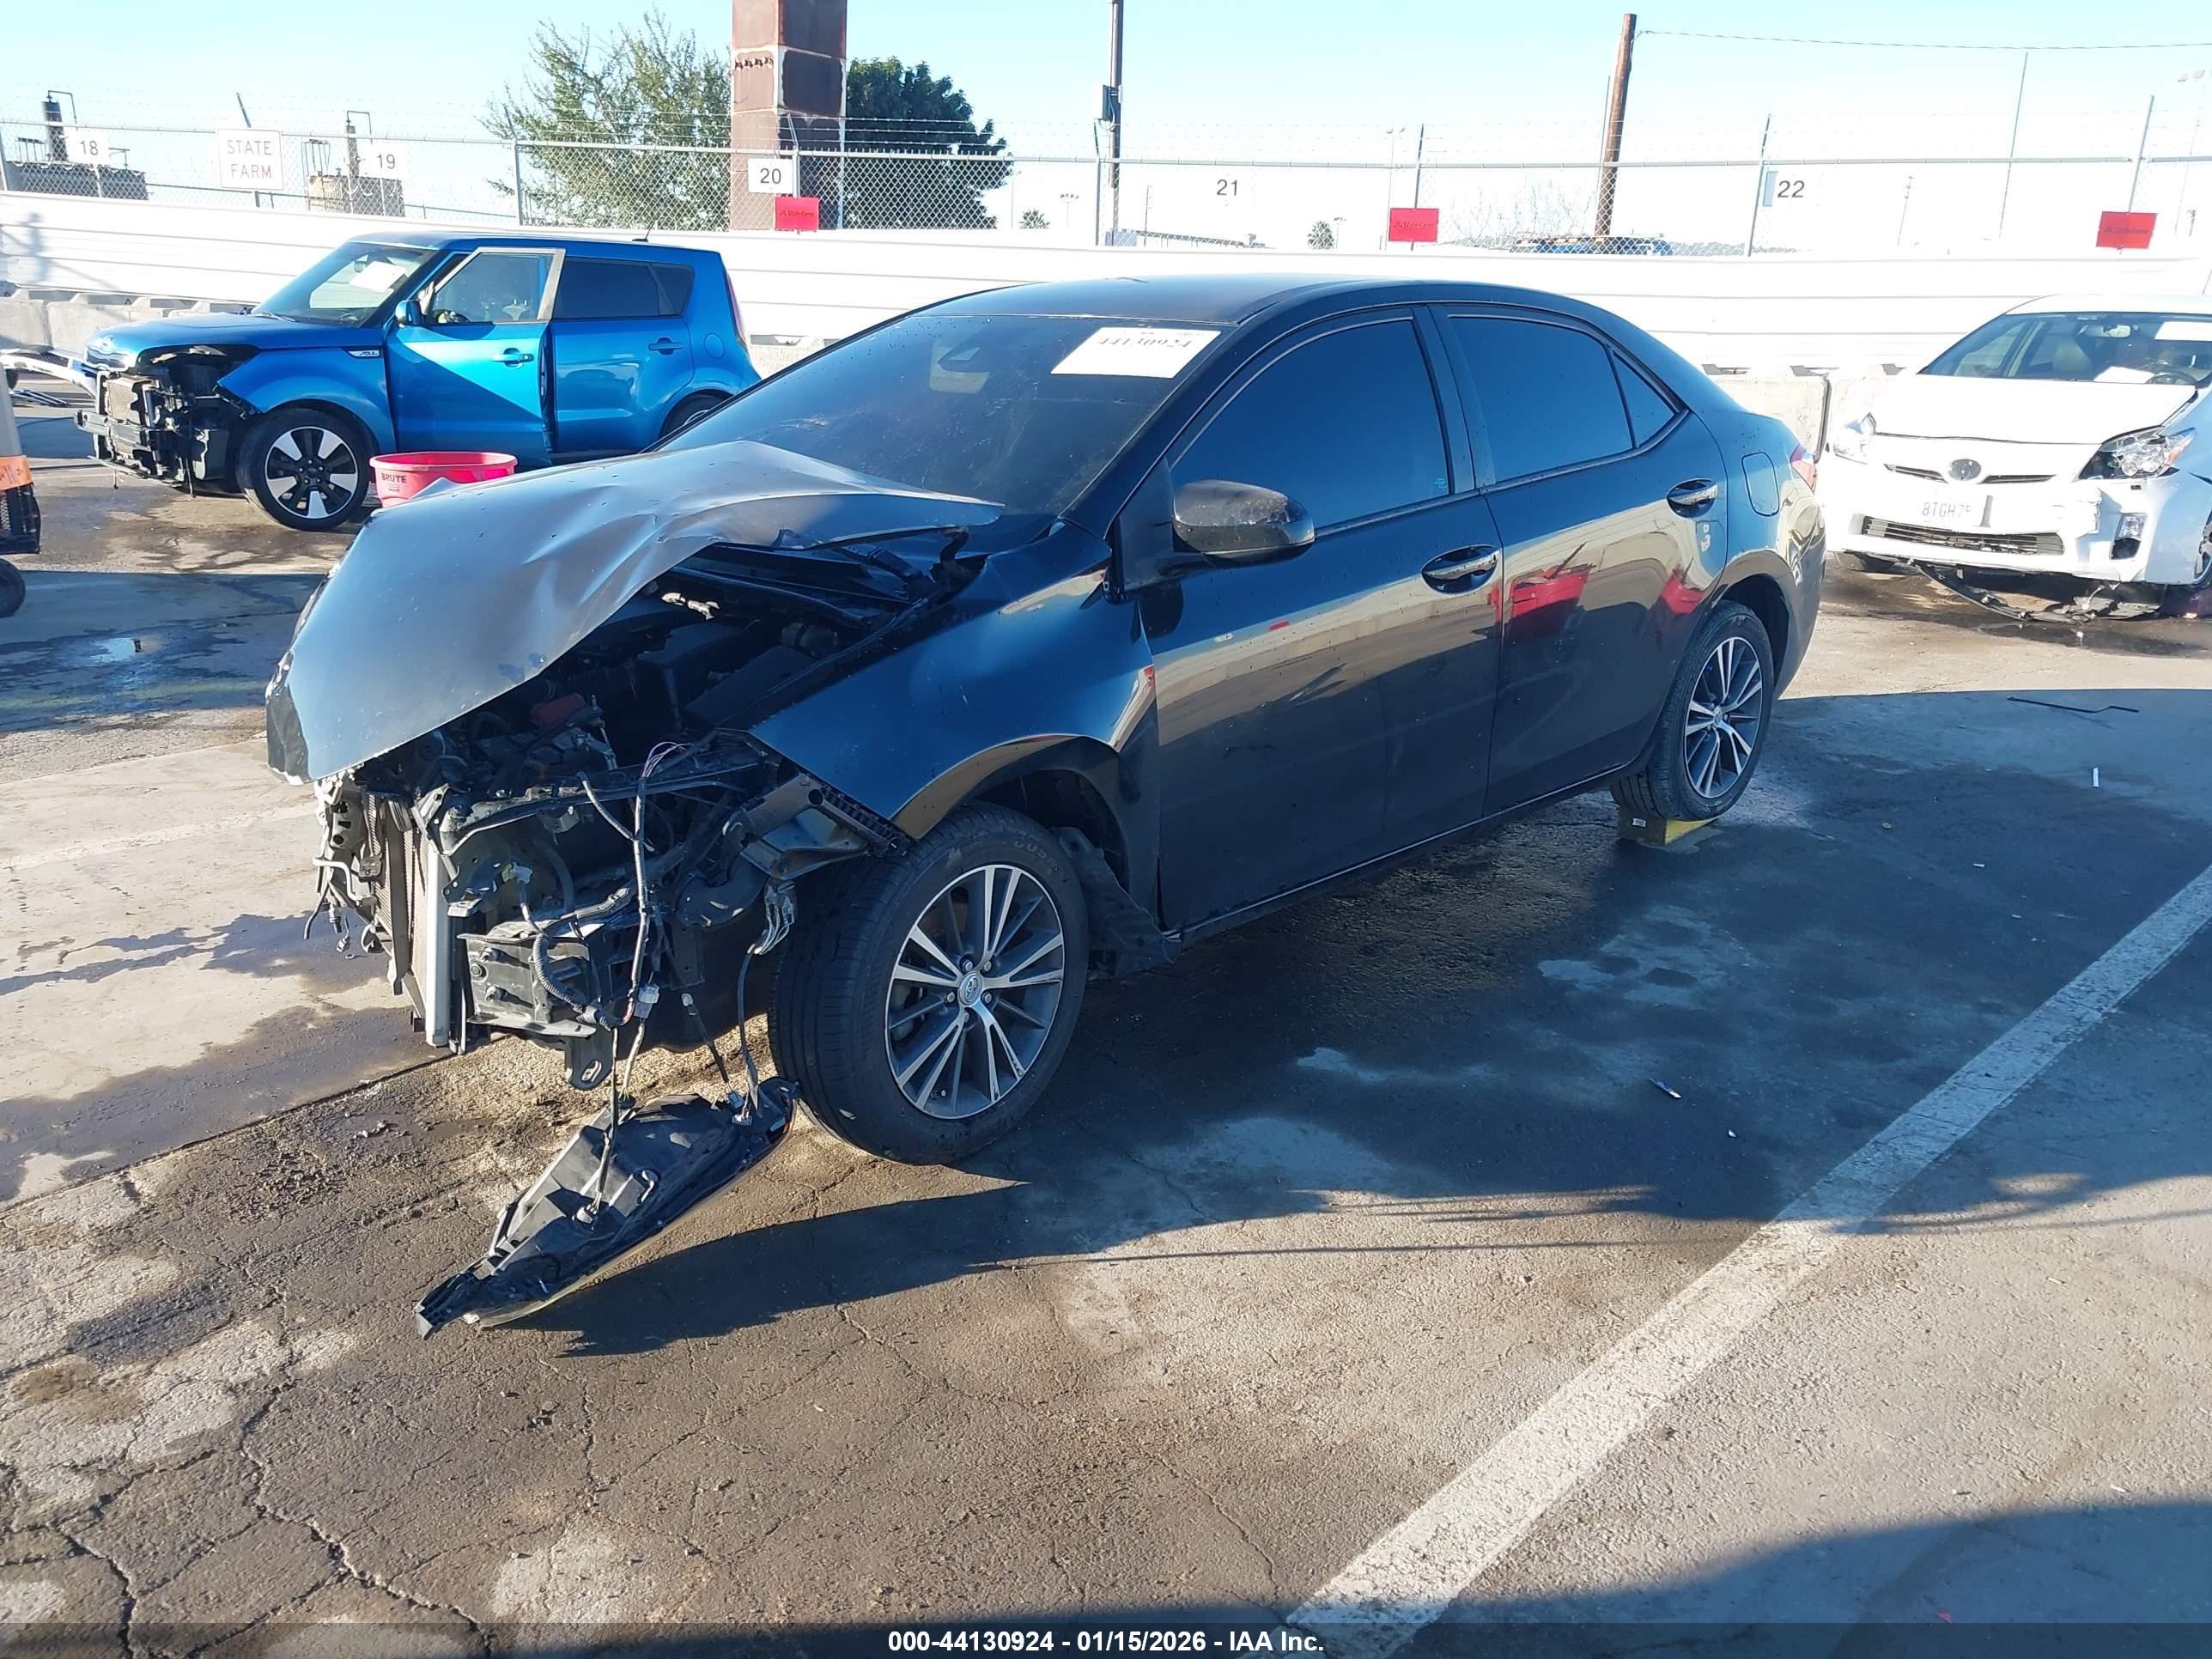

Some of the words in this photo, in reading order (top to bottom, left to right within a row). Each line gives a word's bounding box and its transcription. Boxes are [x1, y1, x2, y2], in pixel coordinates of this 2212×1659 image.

[79, 140, 100, 156] 18
[227, 139, 272, 156] STATE
[377, 154, 396, 170] 19
[230, 163, 272, 180] FARM
[760, 167, 781, 185] 20
[1216, 179, 1237, 197] 21
[1778, 179, 1805, 198] 22
[380, 472, 408, 483] BRUTE
